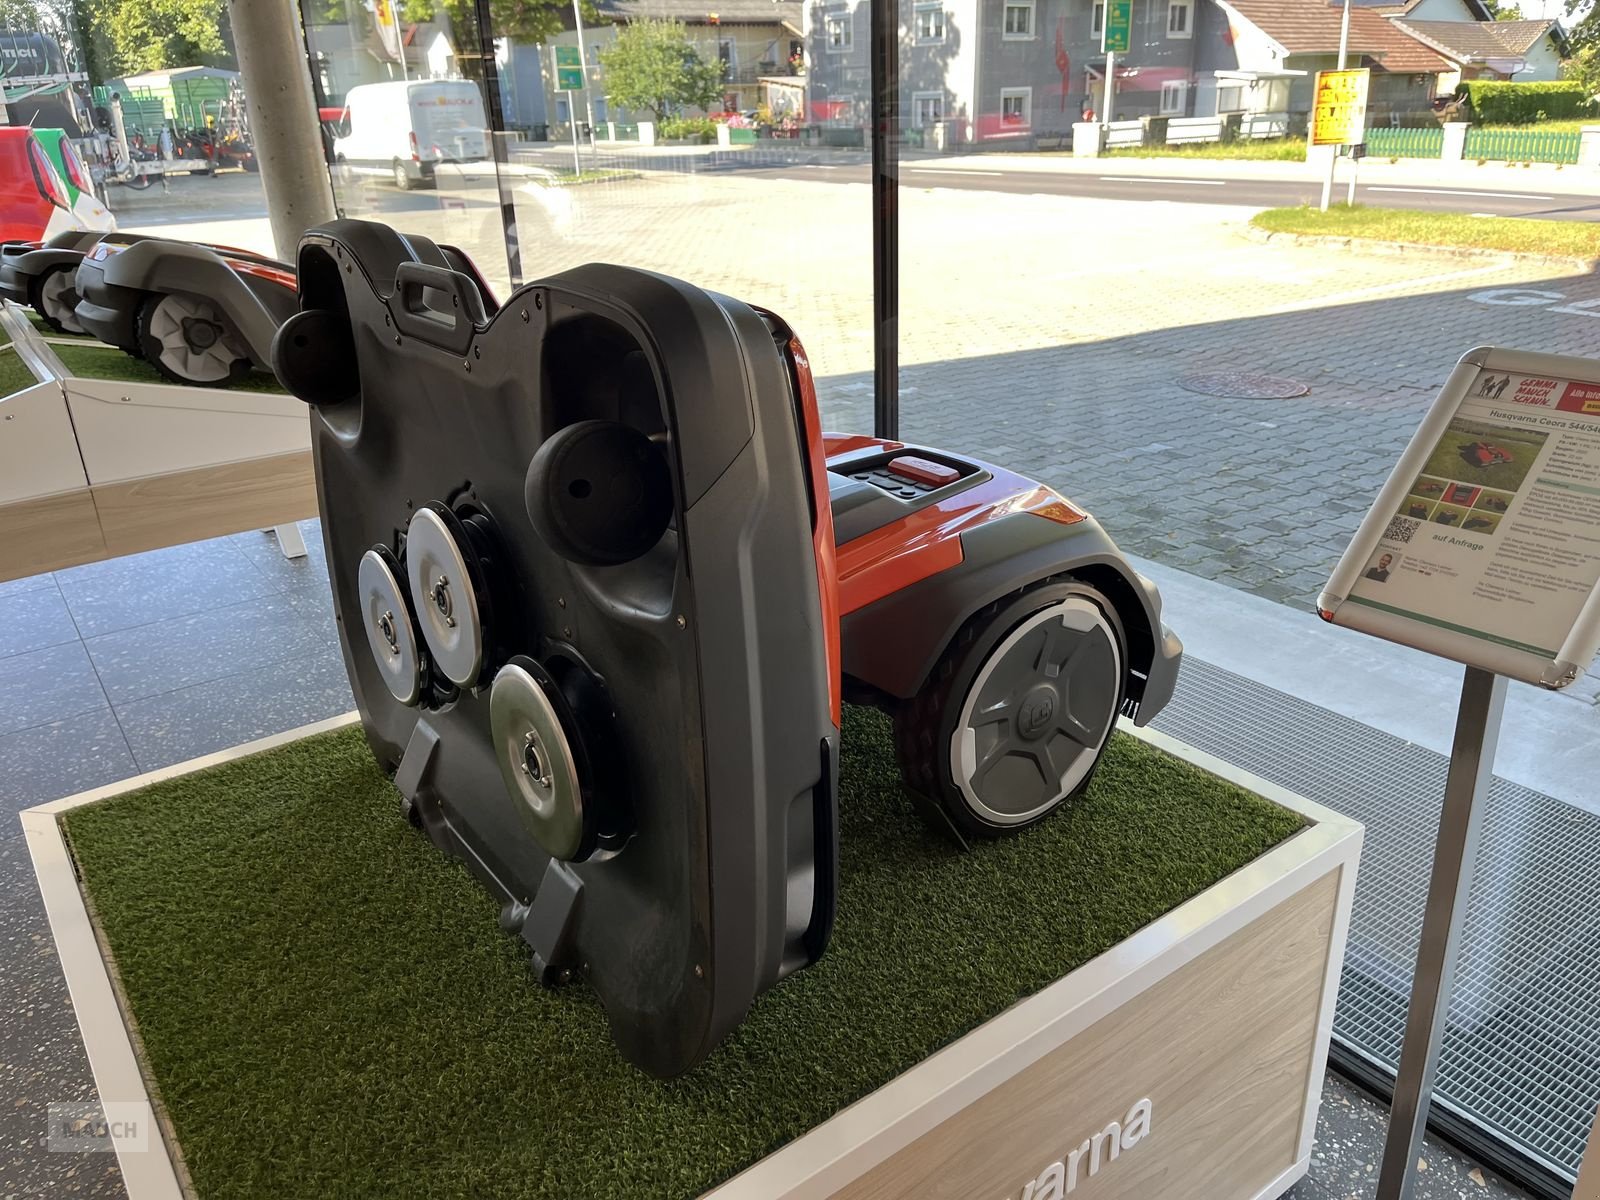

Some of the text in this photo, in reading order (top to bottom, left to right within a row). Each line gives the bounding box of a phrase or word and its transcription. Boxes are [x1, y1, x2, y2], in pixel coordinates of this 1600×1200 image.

[1520, 379, 1558, 389] GEMMA
[1515, 387, 1551, 397] MAUCH
[1490, 410, 1537, 423] Husqvarna
[1539, 418, 1566, 428] Ceora
[1432, 534, 1484, 551] auf Anfrage
